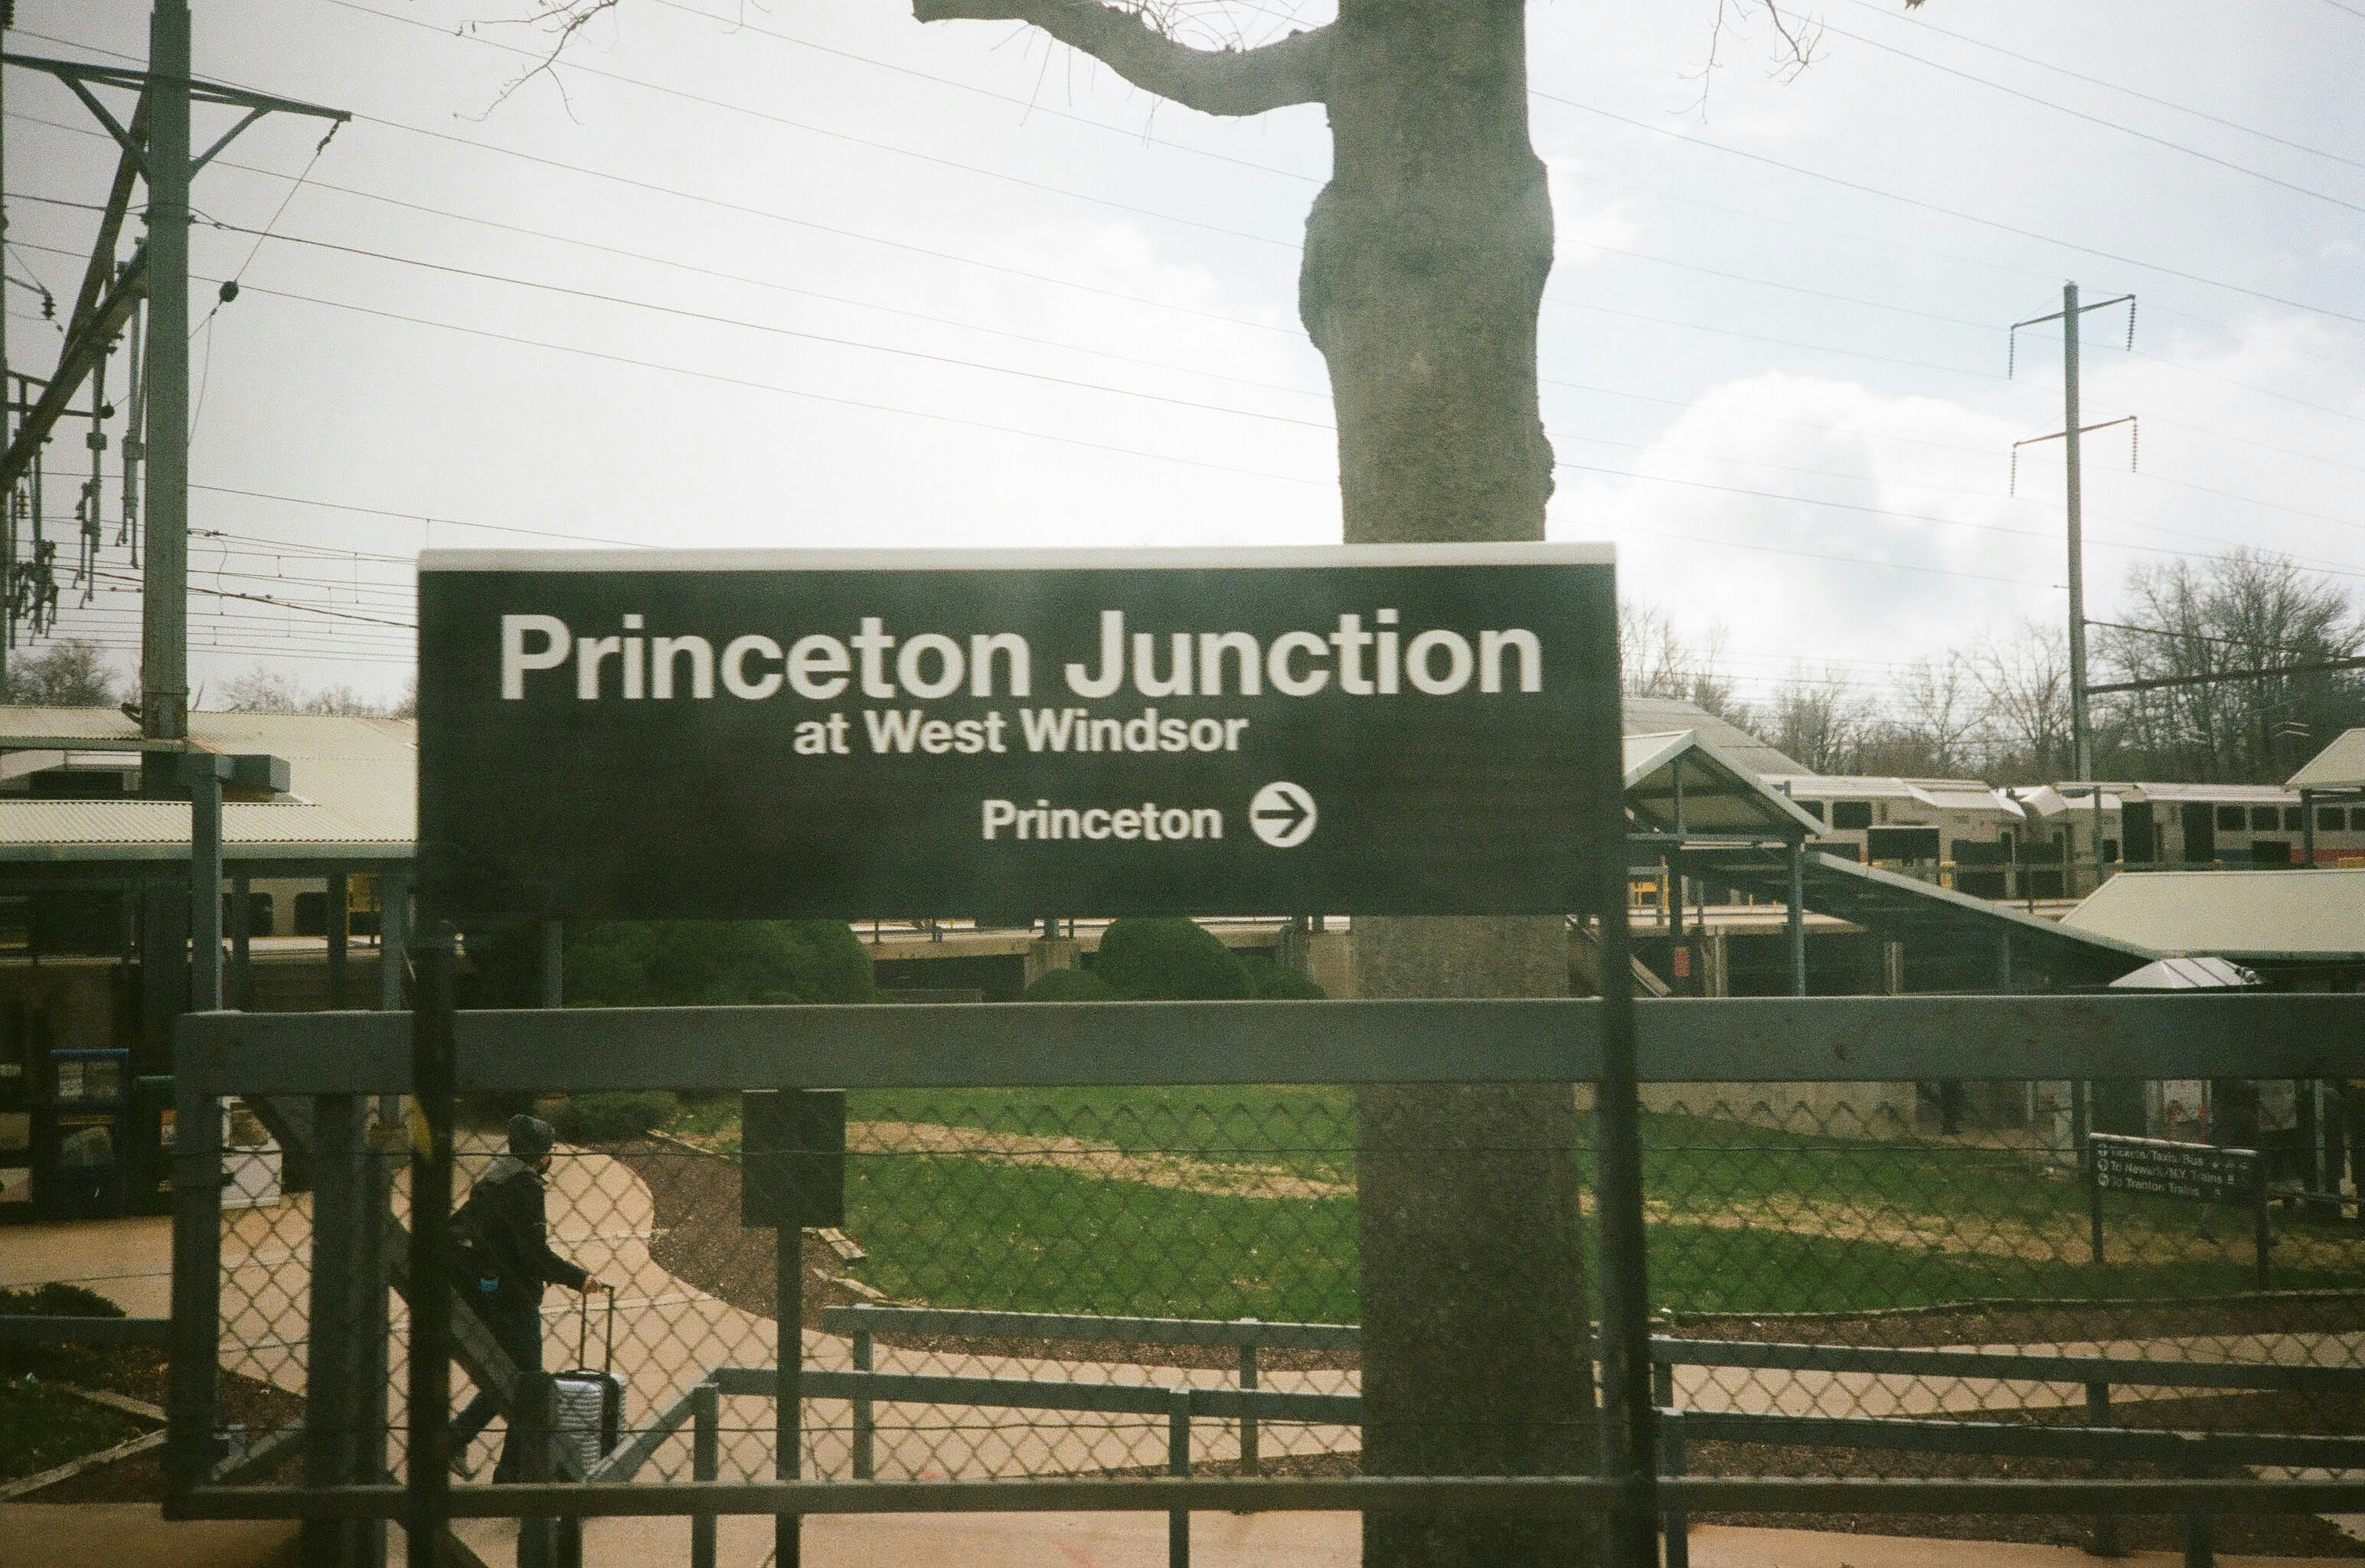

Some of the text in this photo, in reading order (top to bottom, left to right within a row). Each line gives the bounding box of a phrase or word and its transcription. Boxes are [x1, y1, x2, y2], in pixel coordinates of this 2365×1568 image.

[501, 608, 1543, 701] Princeton Junction
[793, 707, 1250, 756] at West Windsor
[982, 799, 1223, 842] Princeton
